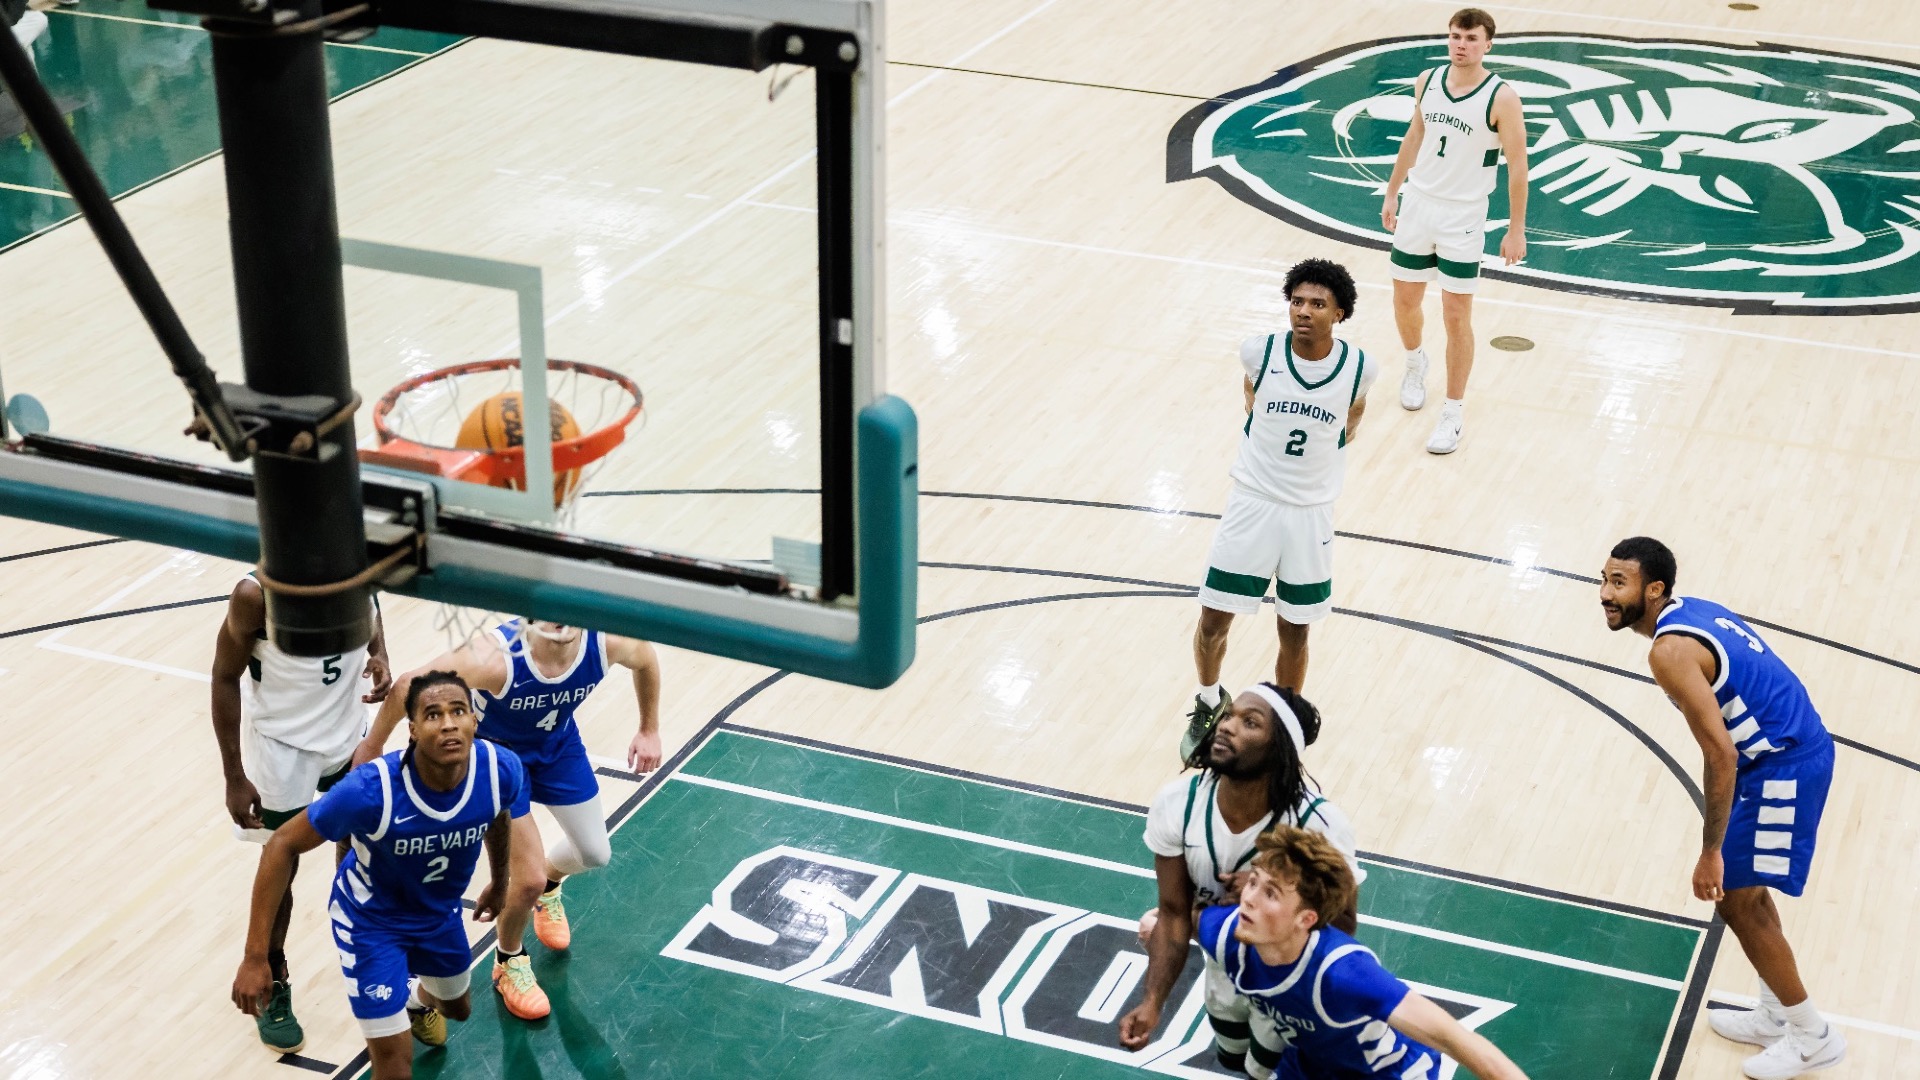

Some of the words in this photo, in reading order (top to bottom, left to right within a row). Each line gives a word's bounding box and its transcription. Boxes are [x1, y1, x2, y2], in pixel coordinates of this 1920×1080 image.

[1425, 112, 1474, 136] PIEDMONT
[1437, 135, 1448, 158] 1
[1266, 401, 1337, 425] PIEDMONT
[1284, 428, 1308, 457] 2
[1714, 617, 1765, 654] 3
[322, 654, 342, 686] 5
[535, 709, 559, 732] 4
[422, 855, 450, 884] 2
